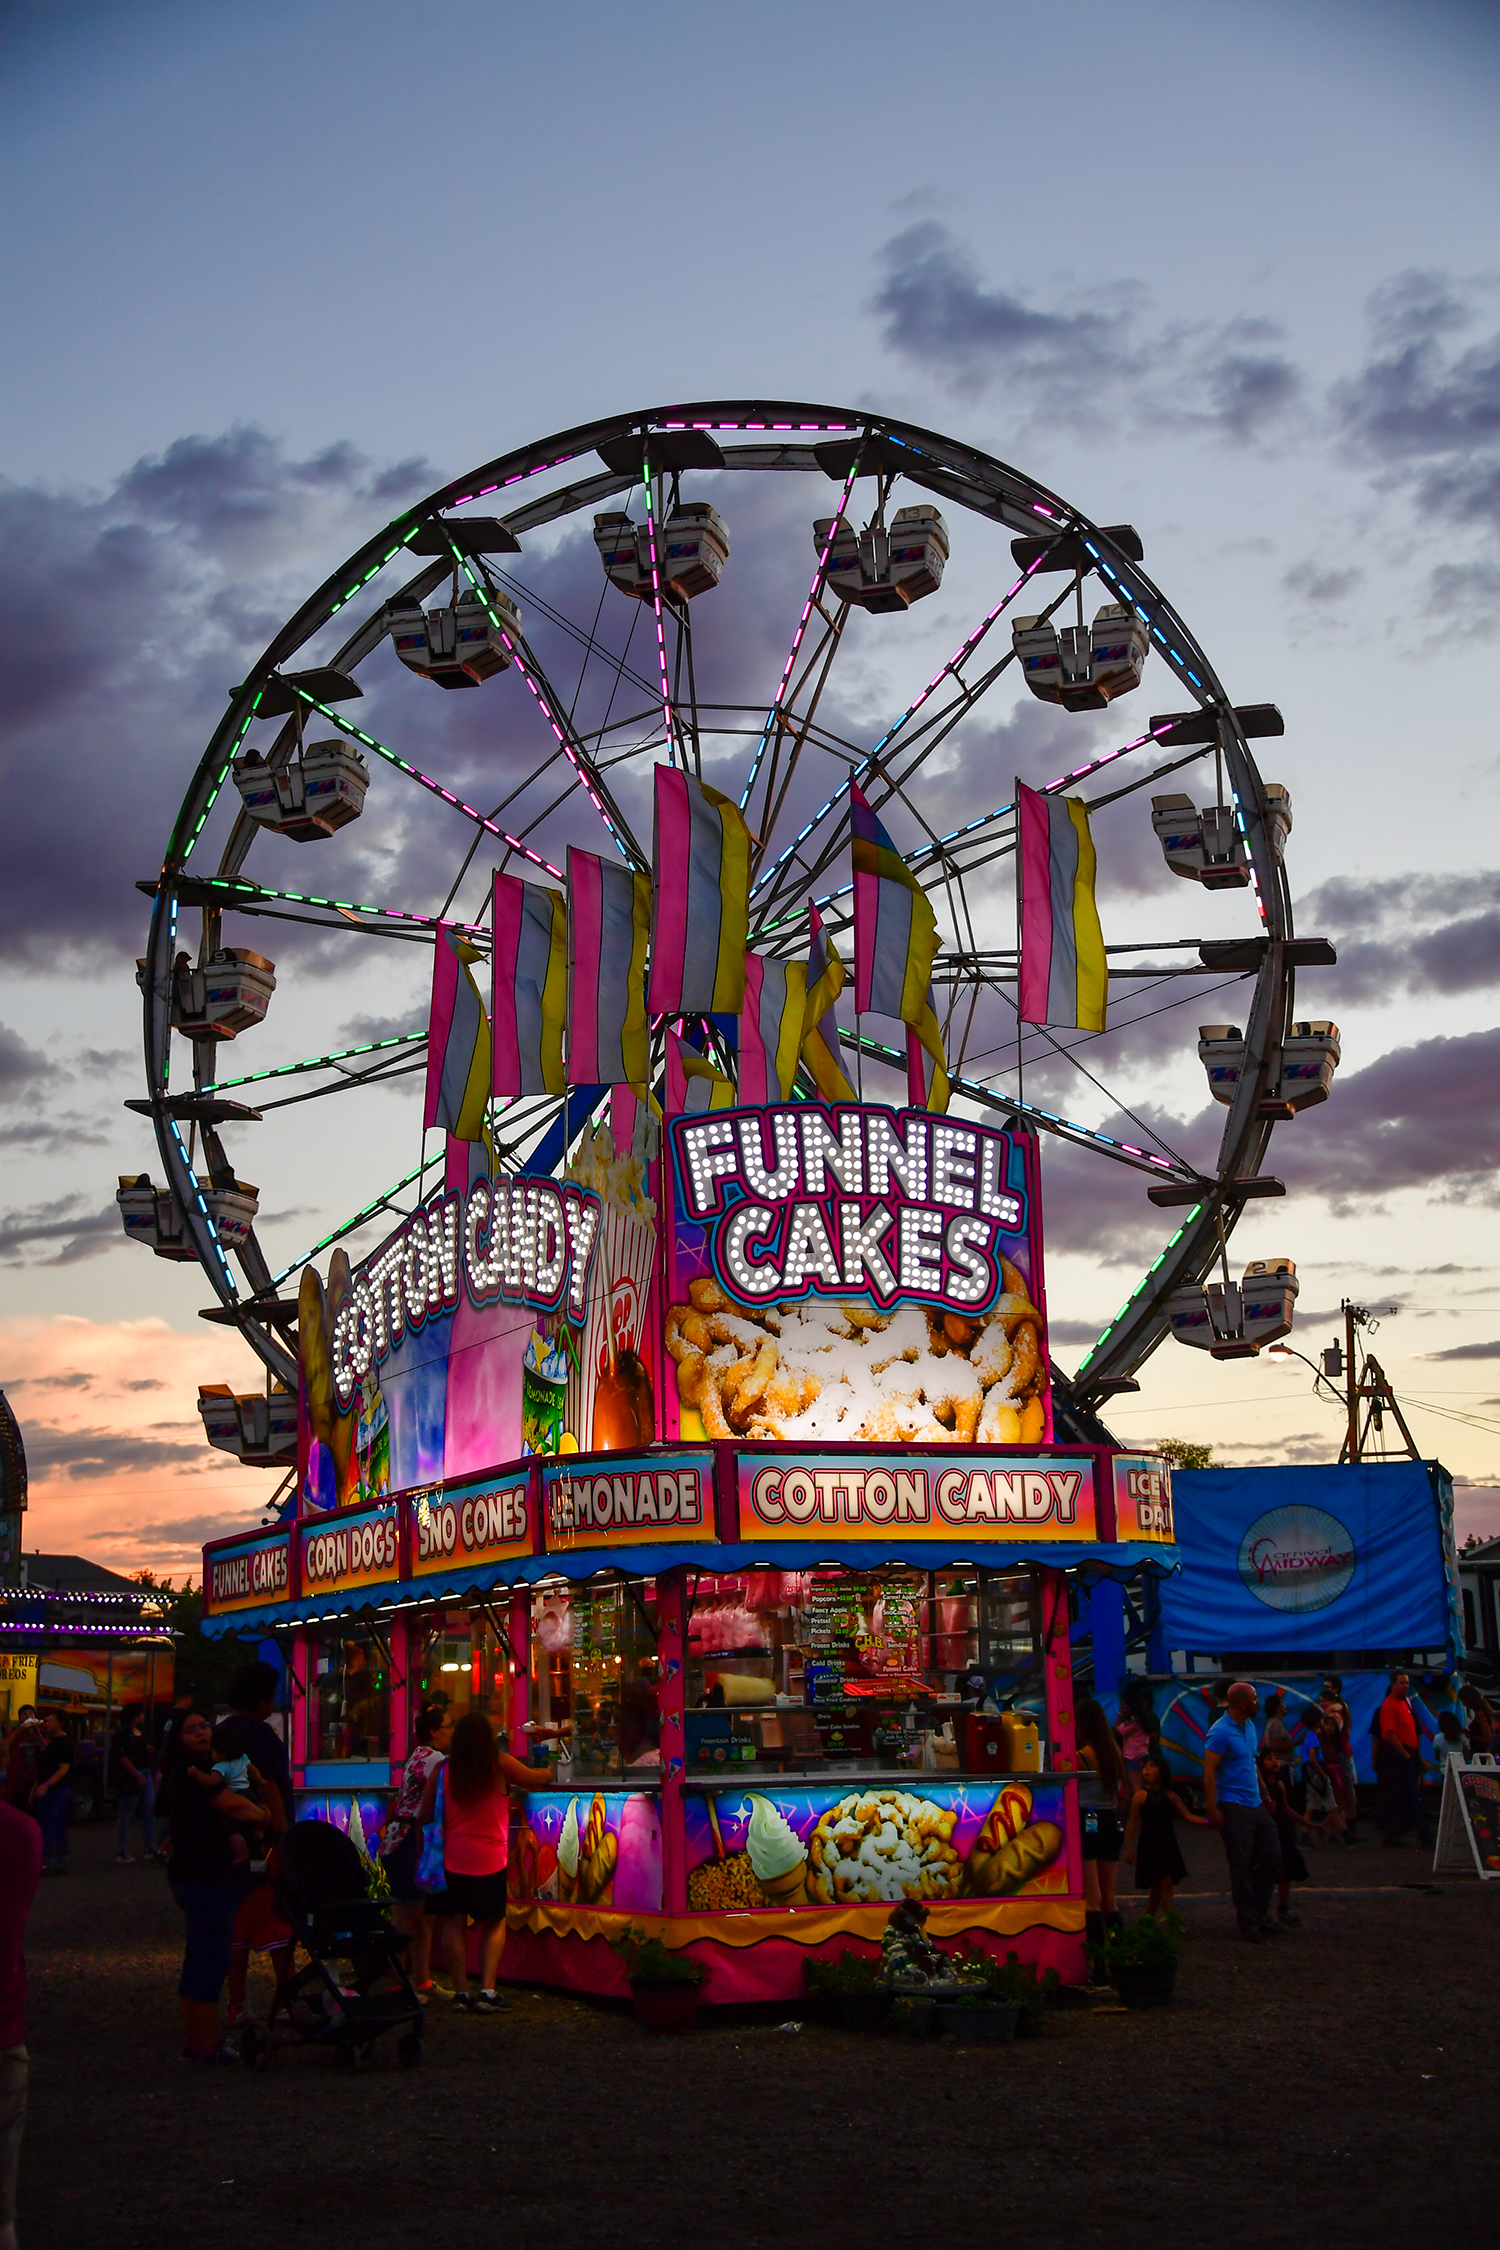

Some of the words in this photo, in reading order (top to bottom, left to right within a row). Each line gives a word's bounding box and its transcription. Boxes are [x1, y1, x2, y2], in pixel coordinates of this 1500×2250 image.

[900, 507, 921, 520] 13
[214, 951, 227, 963] 9
[682, 1112, 1020, 1223] FUNNEL
[724, 1201, 991, 1301] CAKES
[1252, 1262, 1267, 1275] 2
[333, 1198, 459, 1400] COTTON
[464, 1185, 600, 1312] CANDY
[551, 1472, 698, 1529] LEMONADE
[754, 1470, 926, 1521] COTTON
[939, 1470, 1080, 1521] CANDY
[420, 1505, 457, 1558] SNO
[463, 1489, 527, 1549] CONES
[212, 1556, 251, 1600] FUNNEL
[252, 1546, 288, 1593] CAKES
[306, 1530, 348, 1582] CORN
[351, 1519, 396, 1571] DOGS
[811, 1595, 837, 1603] Popcorn
[829, 1606, 848, 1614] Apple
[0, 1669, 27, 1680] REOS
[700, 1737, 730, 1745] Fountain
[730, 1736, 752, 1744] Drinks
